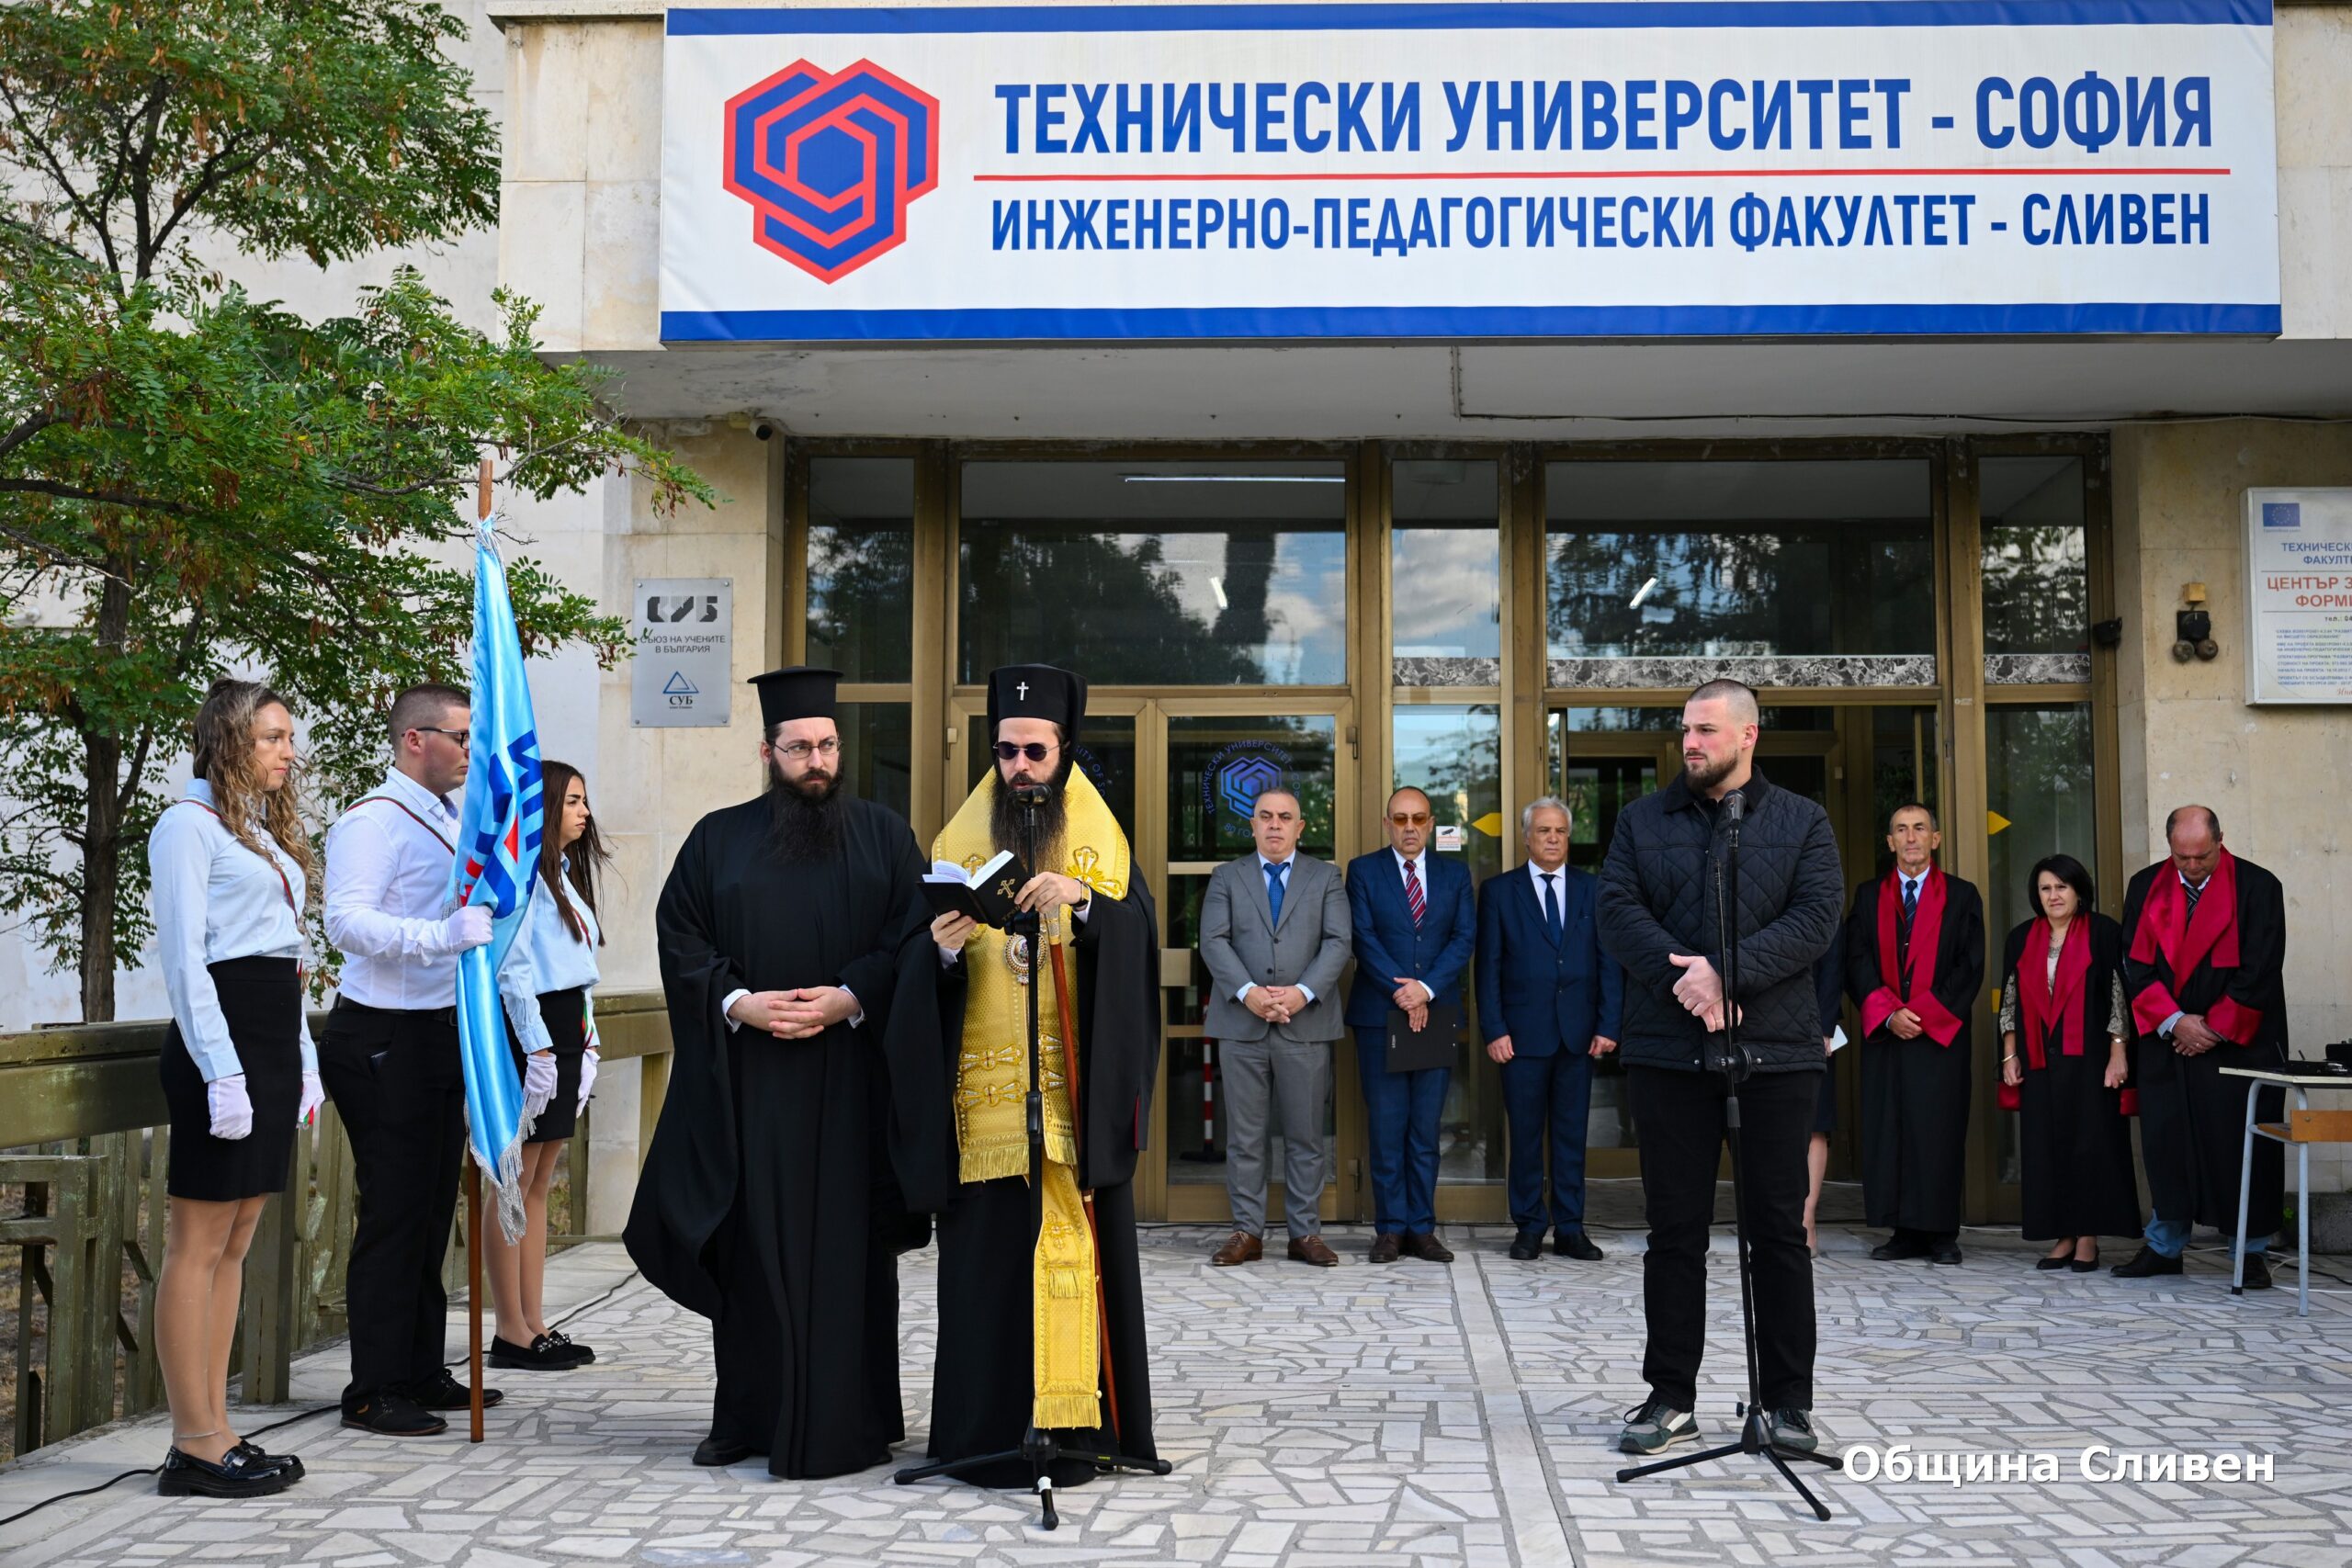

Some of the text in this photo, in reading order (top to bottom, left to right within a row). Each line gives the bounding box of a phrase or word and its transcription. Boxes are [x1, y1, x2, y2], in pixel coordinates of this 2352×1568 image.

[994, 70, 2212, 154] ТЕХНИЧЕСКИ УНИВЕРСИТЕТ - СОФИЯ
[991, 195, 1714, 257] ИНЖЕНЕРНО-ПЕДАГОГИЧЕСКИ
[1729, 191, 1977, 253] ФАКУЛТЕТ
[2022, 192, 2211, 247] СЛИВЕН
[2267, 577, 2339, 592] ЦЕНТЪР
[684, 636, 726, 644] УЧЕНИТЕ
[669, 695, 694, 705] СУБ
[1202, 750, 1226, 816] ТЕХНИЧЕСКИ
[1225, 739, 1294, 765] УНИВЕРСИТЕТ
